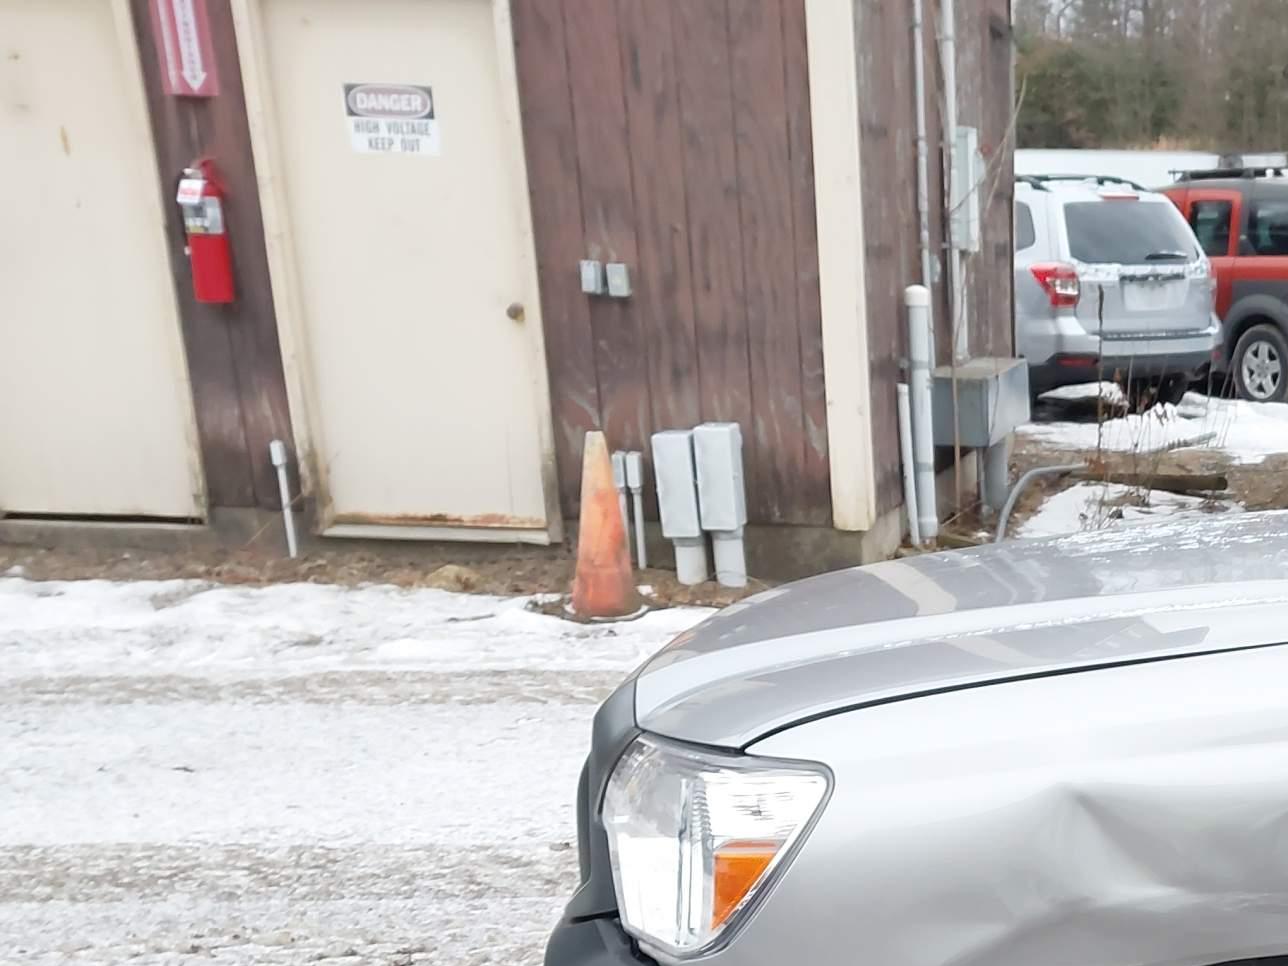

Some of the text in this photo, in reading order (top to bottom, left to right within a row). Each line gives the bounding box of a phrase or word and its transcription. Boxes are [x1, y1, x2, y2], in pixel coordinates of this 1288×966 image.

[356, 92, 421, 111] DANGER
[353, 119, 431, 136] HIGH VOLTAGE
[368, 137, 420, 152] KEEP OUT
